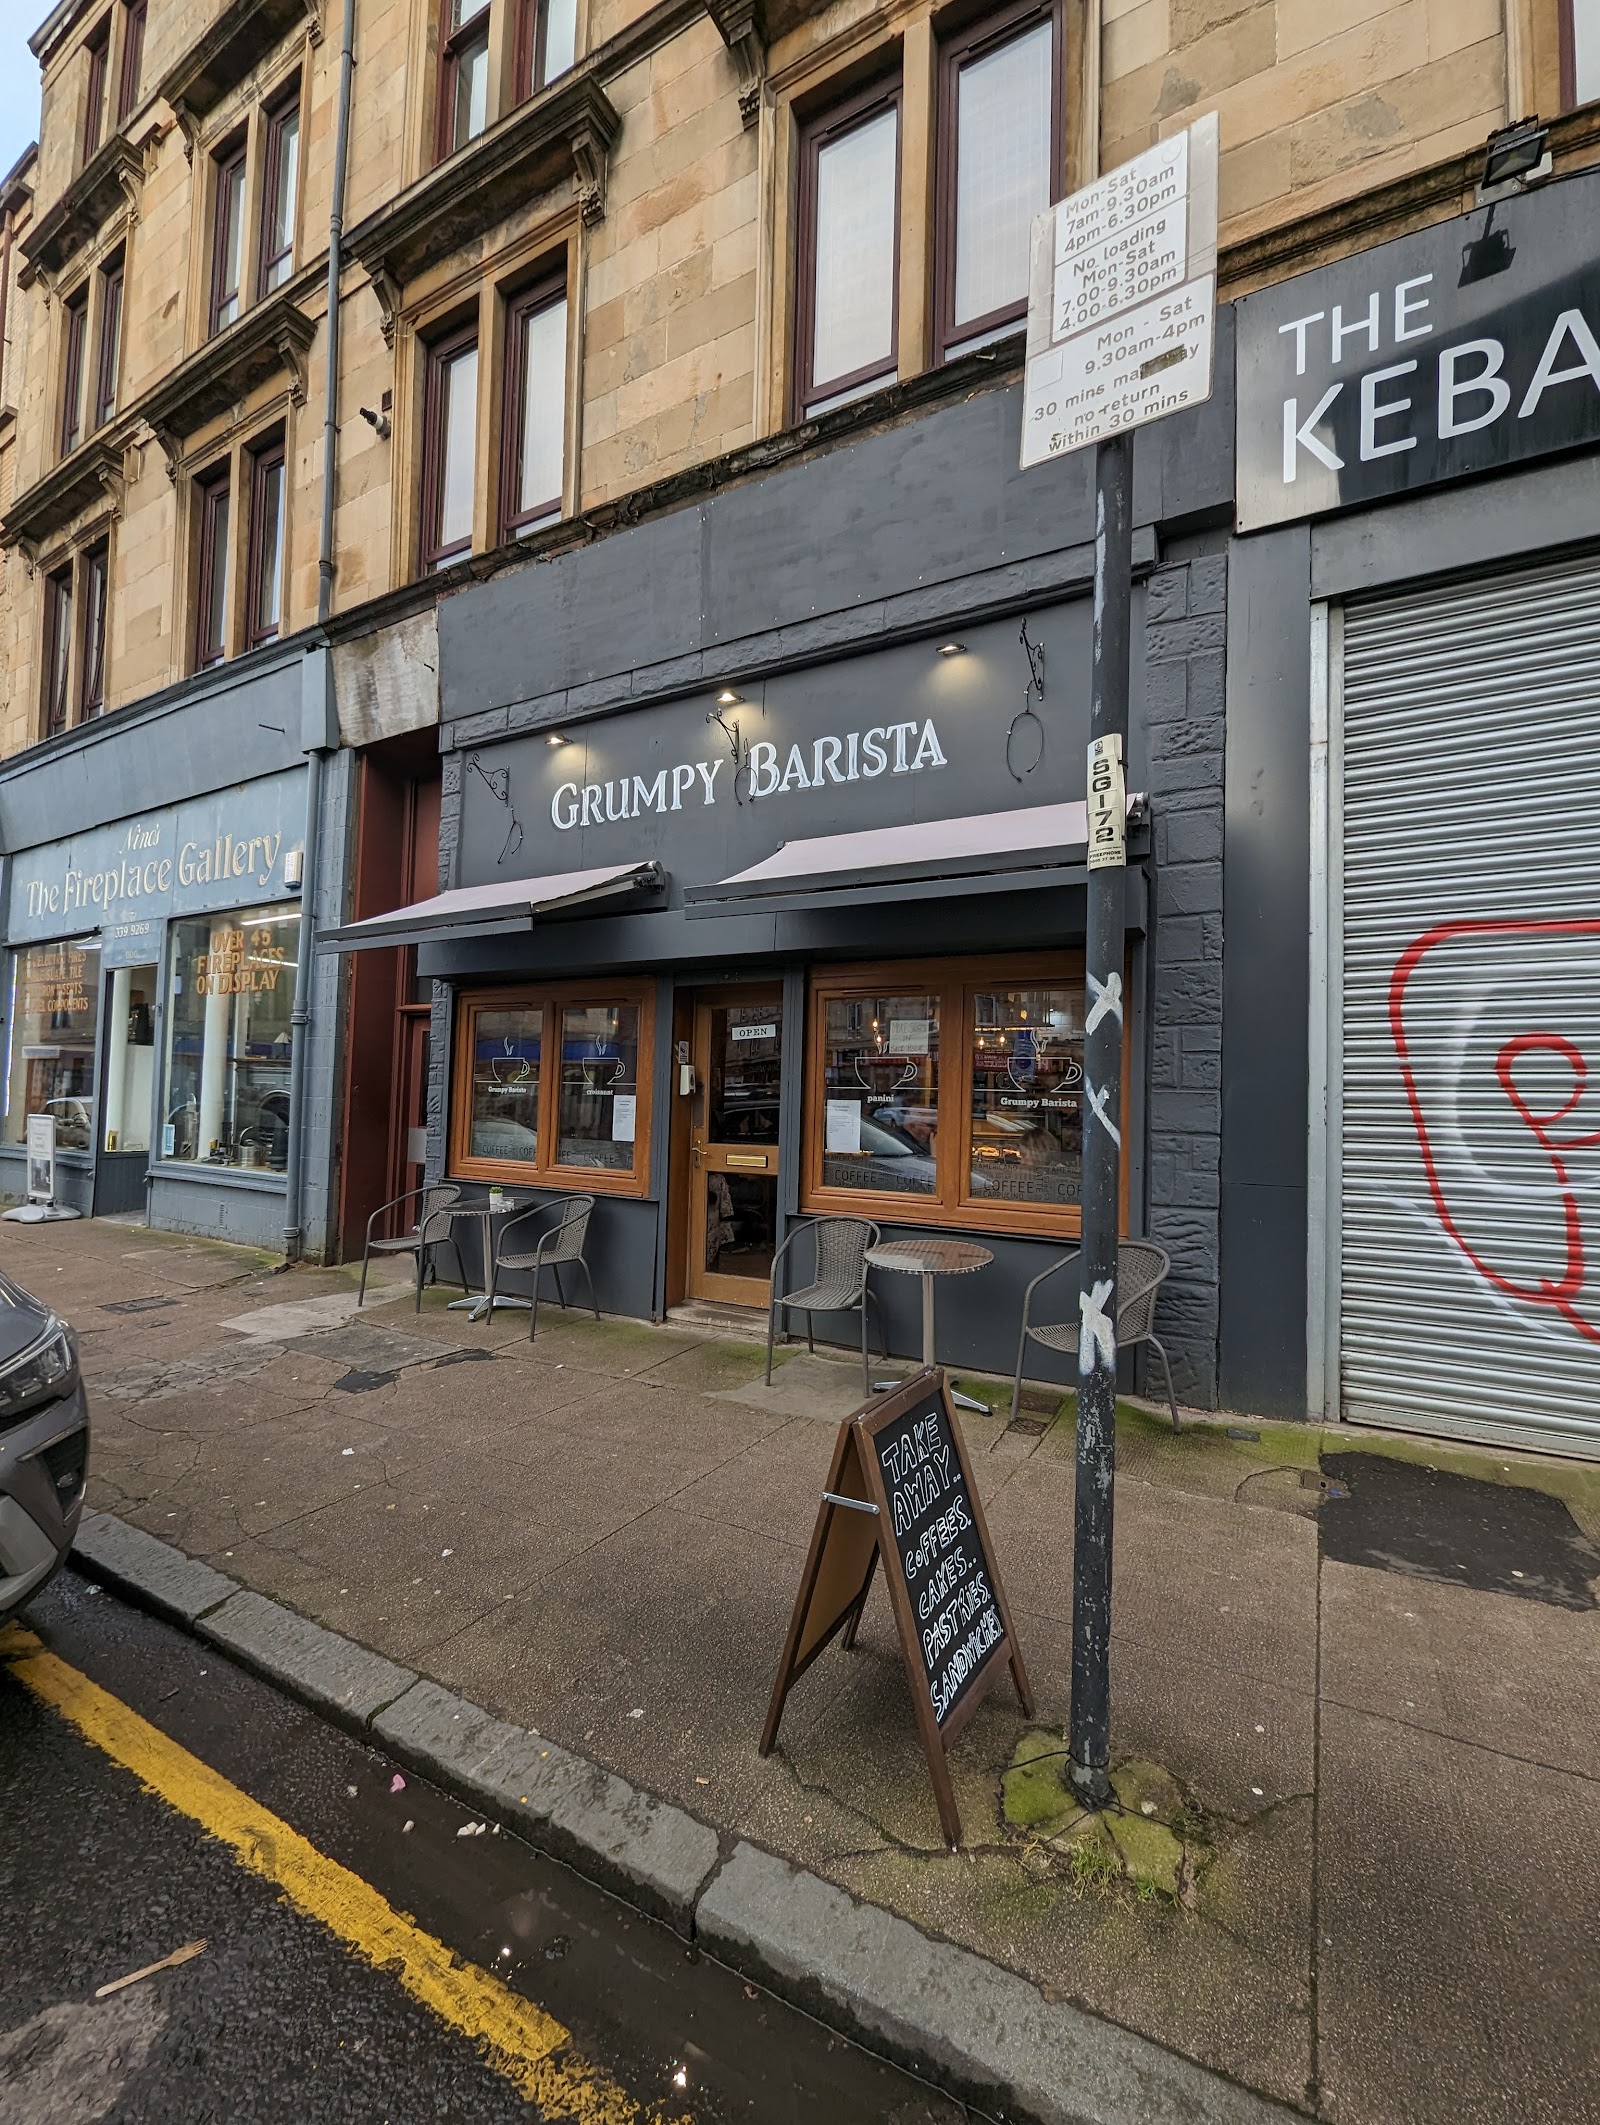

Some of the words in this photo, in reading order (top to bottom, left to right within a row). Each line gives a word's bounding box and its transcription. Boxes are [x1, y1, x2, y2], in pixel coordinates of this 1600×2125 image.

[1064, 184, 1176, 252] 4pm-6.30pm
[1066, 168, 1137, 218] Mon-Sat
[1067, 166, 1174, 234] 7am-9.30am
[1074, 257, 1096, 277] No
[1104, 219, 1167, 260] loading
[1083, 240, 1156, 288] Mon-Sat
[1059, 268, 1177, 331] 4.00-6.30pm
[1062, 250, 1176, 315] 7.00-9.30am
[1084, 313, 1206, 376] 9.30am-4pm
[1097, 326, 1134, 351] Mon
[1160, 296, 1194, 322] Sat
[1278, 273, 1434, 376] THE
[1034, 401, 1058, 422] 30
[1065, 383, 1106, 410] mins
[1048, 424, 1101, 452] within
[1109, 408, 1135, 429] 30
[1144, 390, 1189, 416] mins
[1074, 410, 1095, 427] no
[1100, 383, 1160, 414] return
[1283, 308, 1600, 484] KEBA
[551, 758, 725, 830] GRUMPY
[749, 718, 949, 799] BARISTA
[26, 879, 59, 920] The
[62, 858, 172, 917] Fireplace
[178, 831, 282, 887] Gallery
[130, 922, 150, 936] 9269
[211, 930, 245, 953] OVER
[251, 928, 272, 947] 45
[196, 973, 214, 996] ON
[218, 969, 280, 995] DISPLAY
[197, 946, 285, 974] FIREPLACES
[738, 1026, 769, 1038] OPEN
[488, 1086, 508, 1095] Grumpy
[867, 1094, 895, 1103] panini
[1000, 1096, 1039, 1109] Grumpy
[1040, 1098, 1078, 1108] Barista
[835, 1169, 877, 1183] COFFEE
[984, 1179, 1034, 1194] COFFEE
[882, 1411, 943, 1485] TAKE
